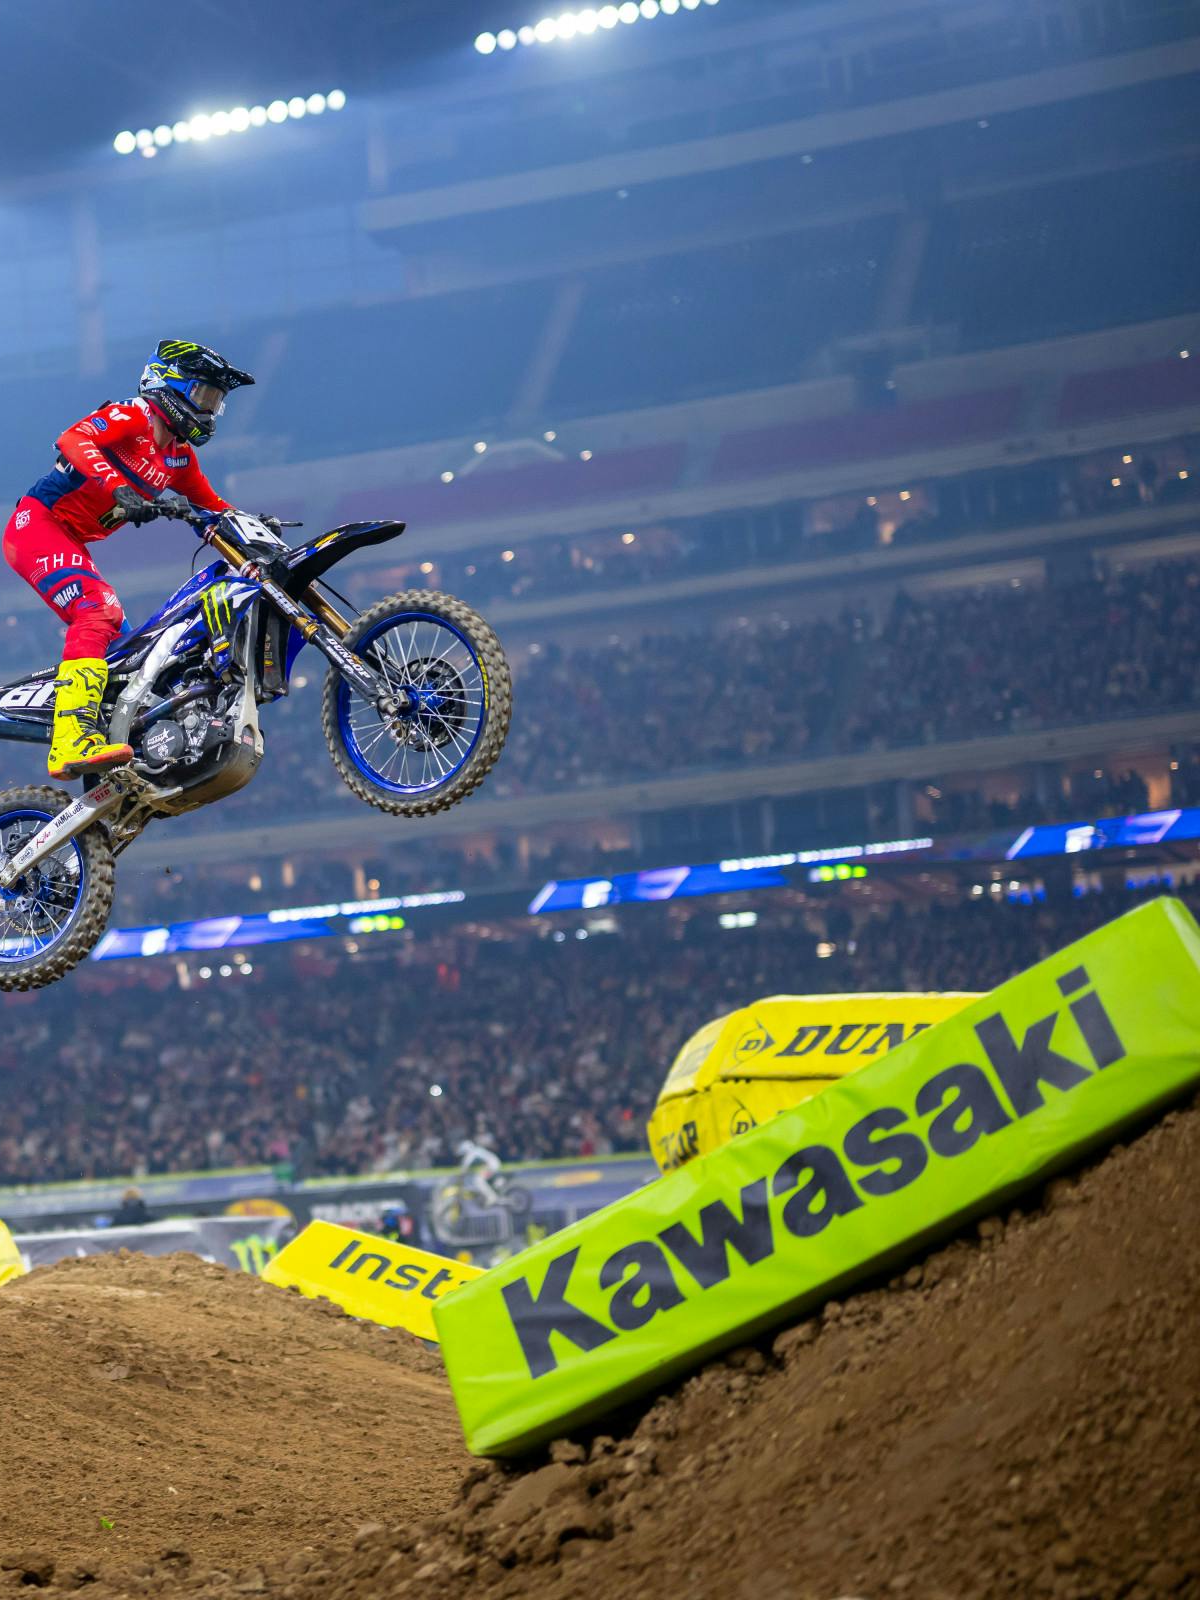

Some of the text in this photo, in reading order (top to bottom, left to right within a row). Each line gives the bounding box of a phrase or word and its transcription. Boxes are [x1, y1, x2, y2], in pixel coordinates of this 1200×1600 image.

[54, 803, 84, 829] YAMALUBE
[500, 964, 1128, 1381] Kawasaki
[328, 1239, 468, 1300] Inst
